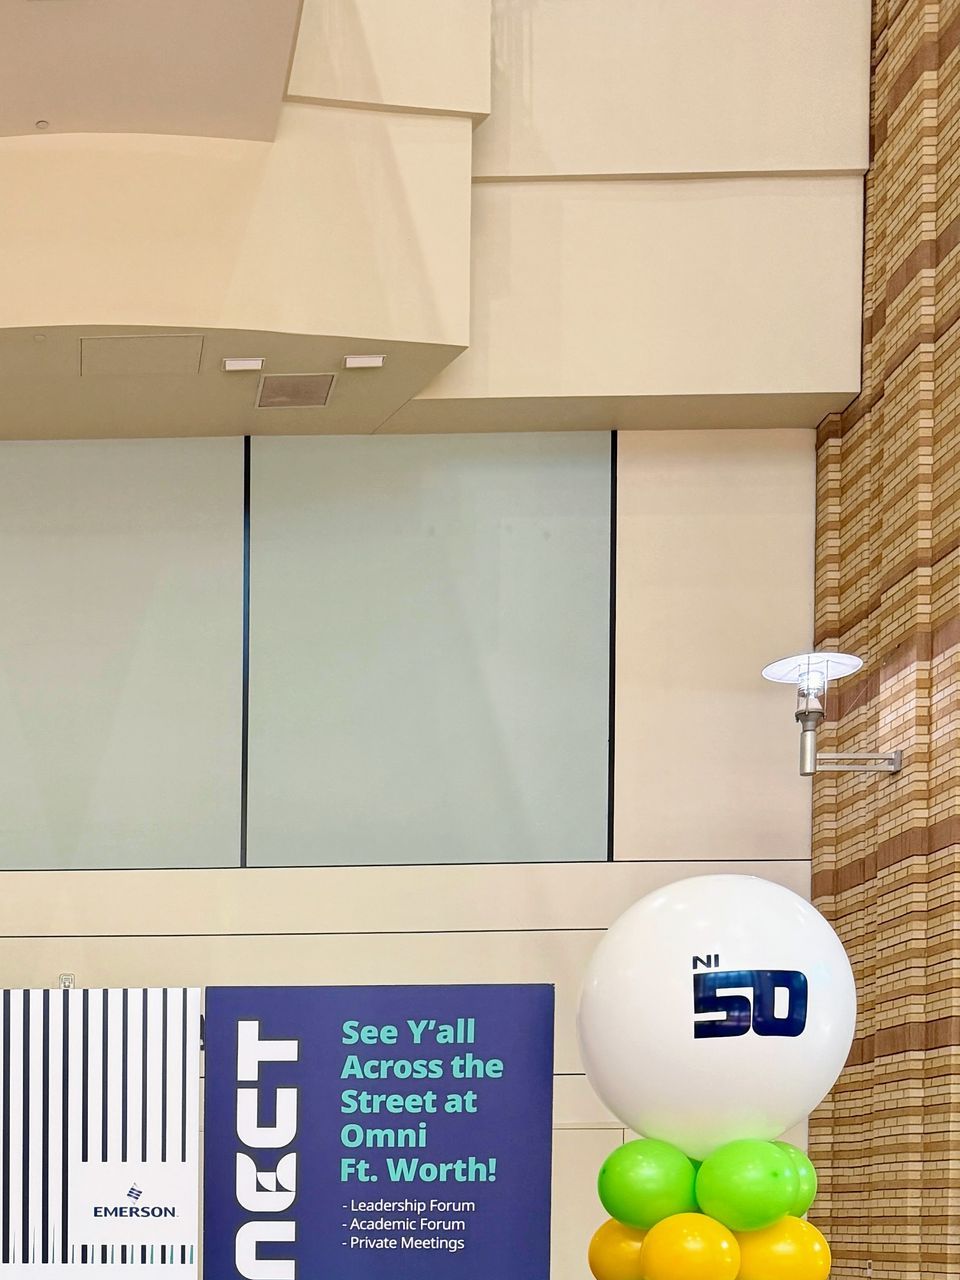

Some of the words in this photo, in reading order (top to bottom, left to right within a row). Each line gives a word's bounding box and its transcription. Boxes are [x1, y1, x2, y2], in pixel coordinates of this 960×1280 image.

[692, 954, 720, 969] NI
[693, 969, 808, 1039] 50
[342, 1020, 398, 1045] See
[340, 1055, 444, 1079] Across
[450, 1052, 504, 1079] the
[340, 1089, 437, 1114] Street
[444, 1090, 478, 1113] at
[340, 1121, 427, 1148] Omni
[340, 1158, 378, 1182] Ft.
[386, 1156, 497, 1182] Worth!
[93, 1206, 176, 1218] EMERSON
[351, 1198, 427, 1215] Leadership
[430, 1199, 475, 1212] Forum
[349, 1217, 417, 1231] Academic
[420, 1217, 466, 1231] Forum
[350, 1236, 398, 1249] Private
[401, 1236, 465, 1253] Meetings
